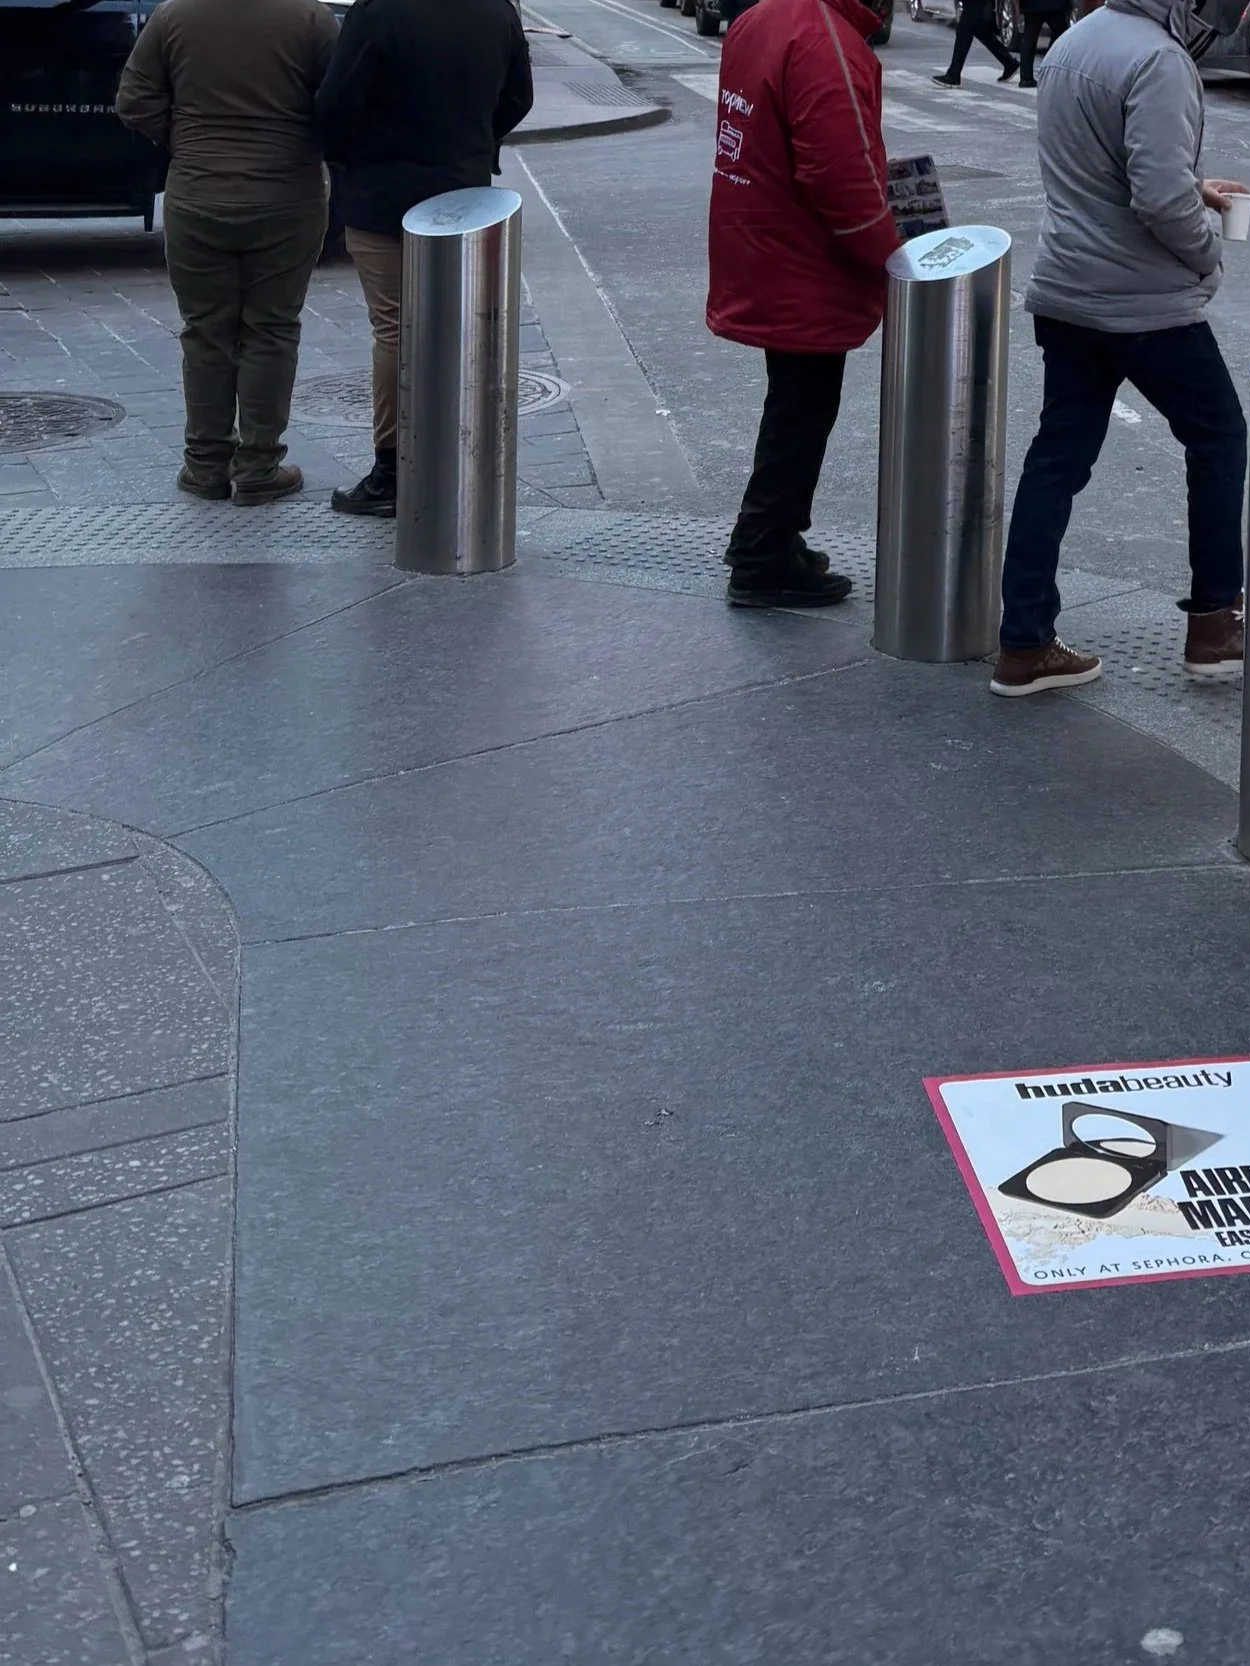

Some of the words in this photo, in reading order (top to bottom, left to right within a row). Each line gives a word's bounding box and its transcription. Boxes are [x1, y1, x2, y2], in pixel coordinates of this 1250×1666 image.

[1015, 1069, 1233, 1100] hudabeauty
[1034, 1266, 1086, 1280] ONLY
[1100, 1263, 1121, 1273] AT
[1132, 1253, 1232, 1270] SEPHORA.
